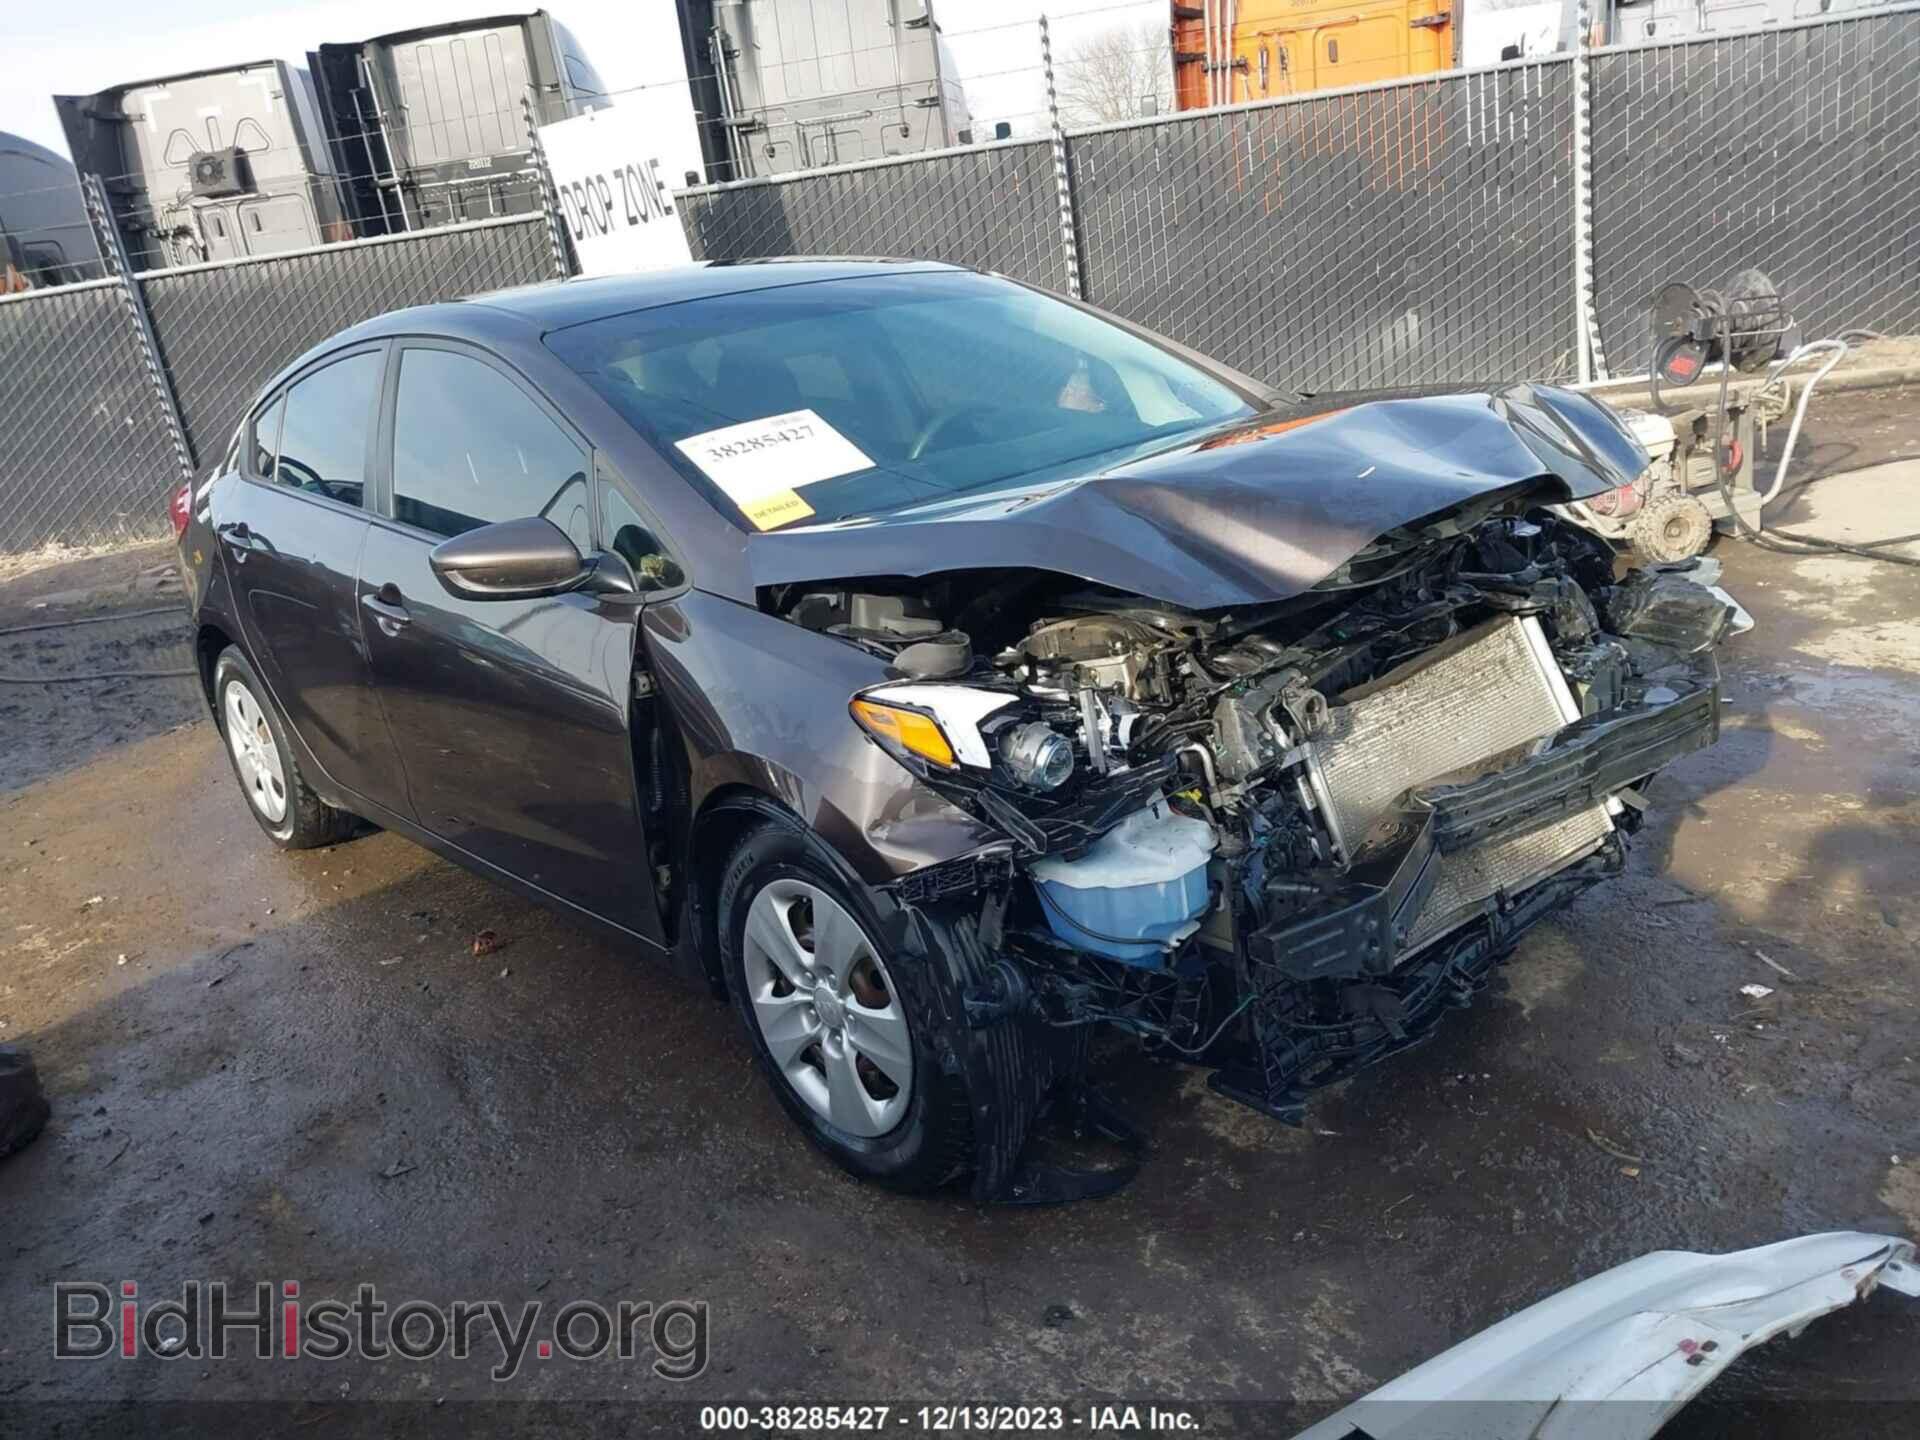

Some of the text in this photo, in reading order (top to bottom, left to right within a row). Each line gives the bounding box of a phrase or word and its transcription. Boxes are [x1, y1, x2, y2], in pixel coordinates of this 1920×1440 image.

[560, 158, 673, 241] DROP ZONE
[706, 424, 815, 463] 38285427
[753, 500, 800, 519] DETAILED
